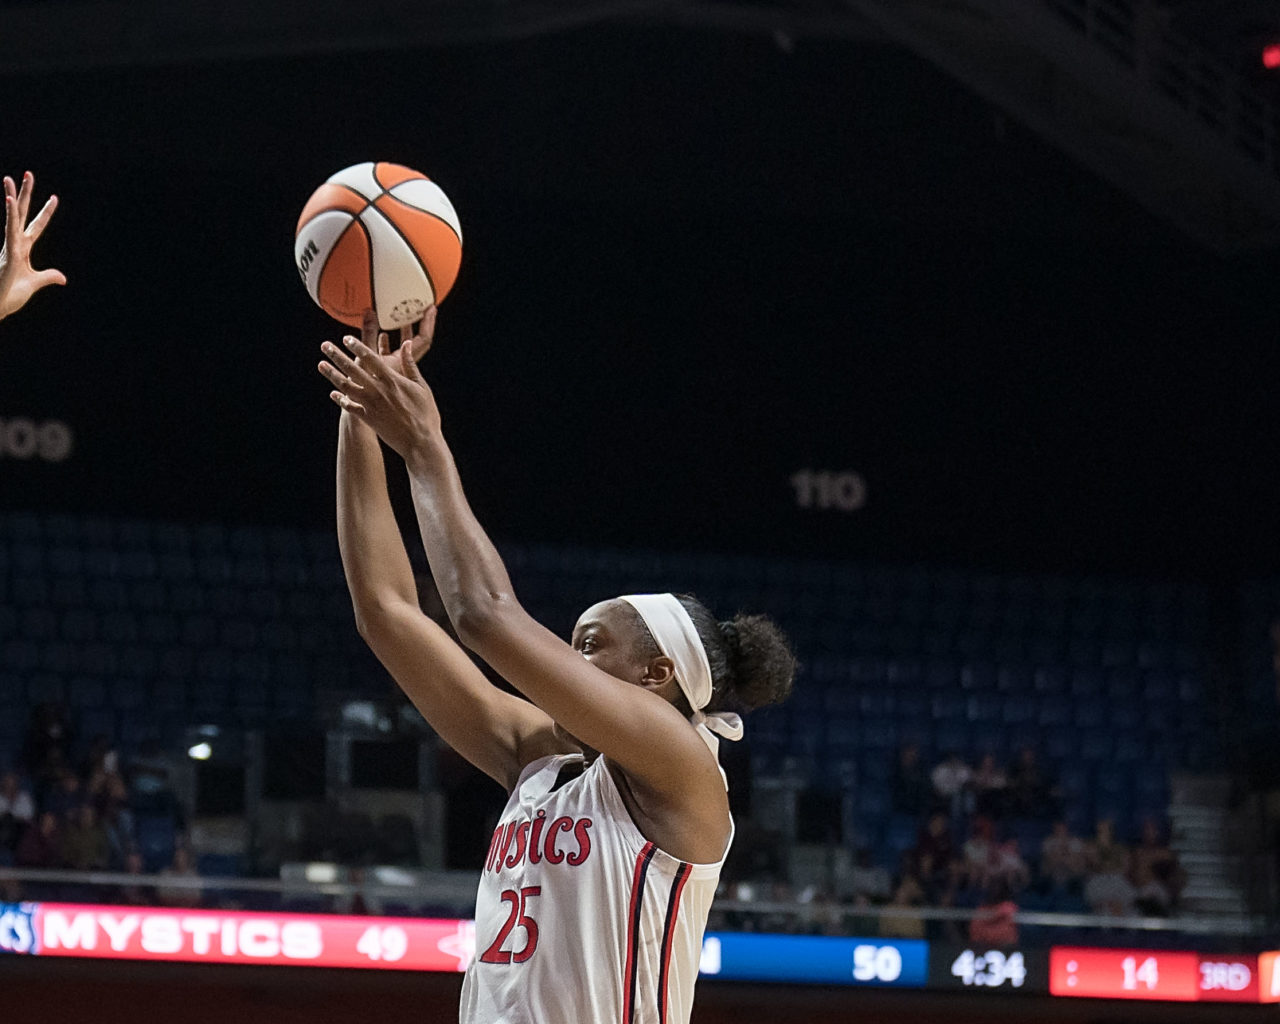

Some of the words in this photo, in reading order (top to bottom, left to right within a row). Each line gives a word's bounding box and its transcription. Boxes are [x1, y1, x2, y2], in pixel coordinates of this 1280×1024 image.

[790, 470, 866, 509] 110
[43, 910, 324, 960] MYSTICS
[356, 925, 408, 961] 49
[480, 886, 542, 965] 25
[853, 945, 902, 981] 50
[951, 949, 1027, 987] 4:34
[1122, 956, 1159, 990] 14
[1199, 961, 1252, 991] 3RD
